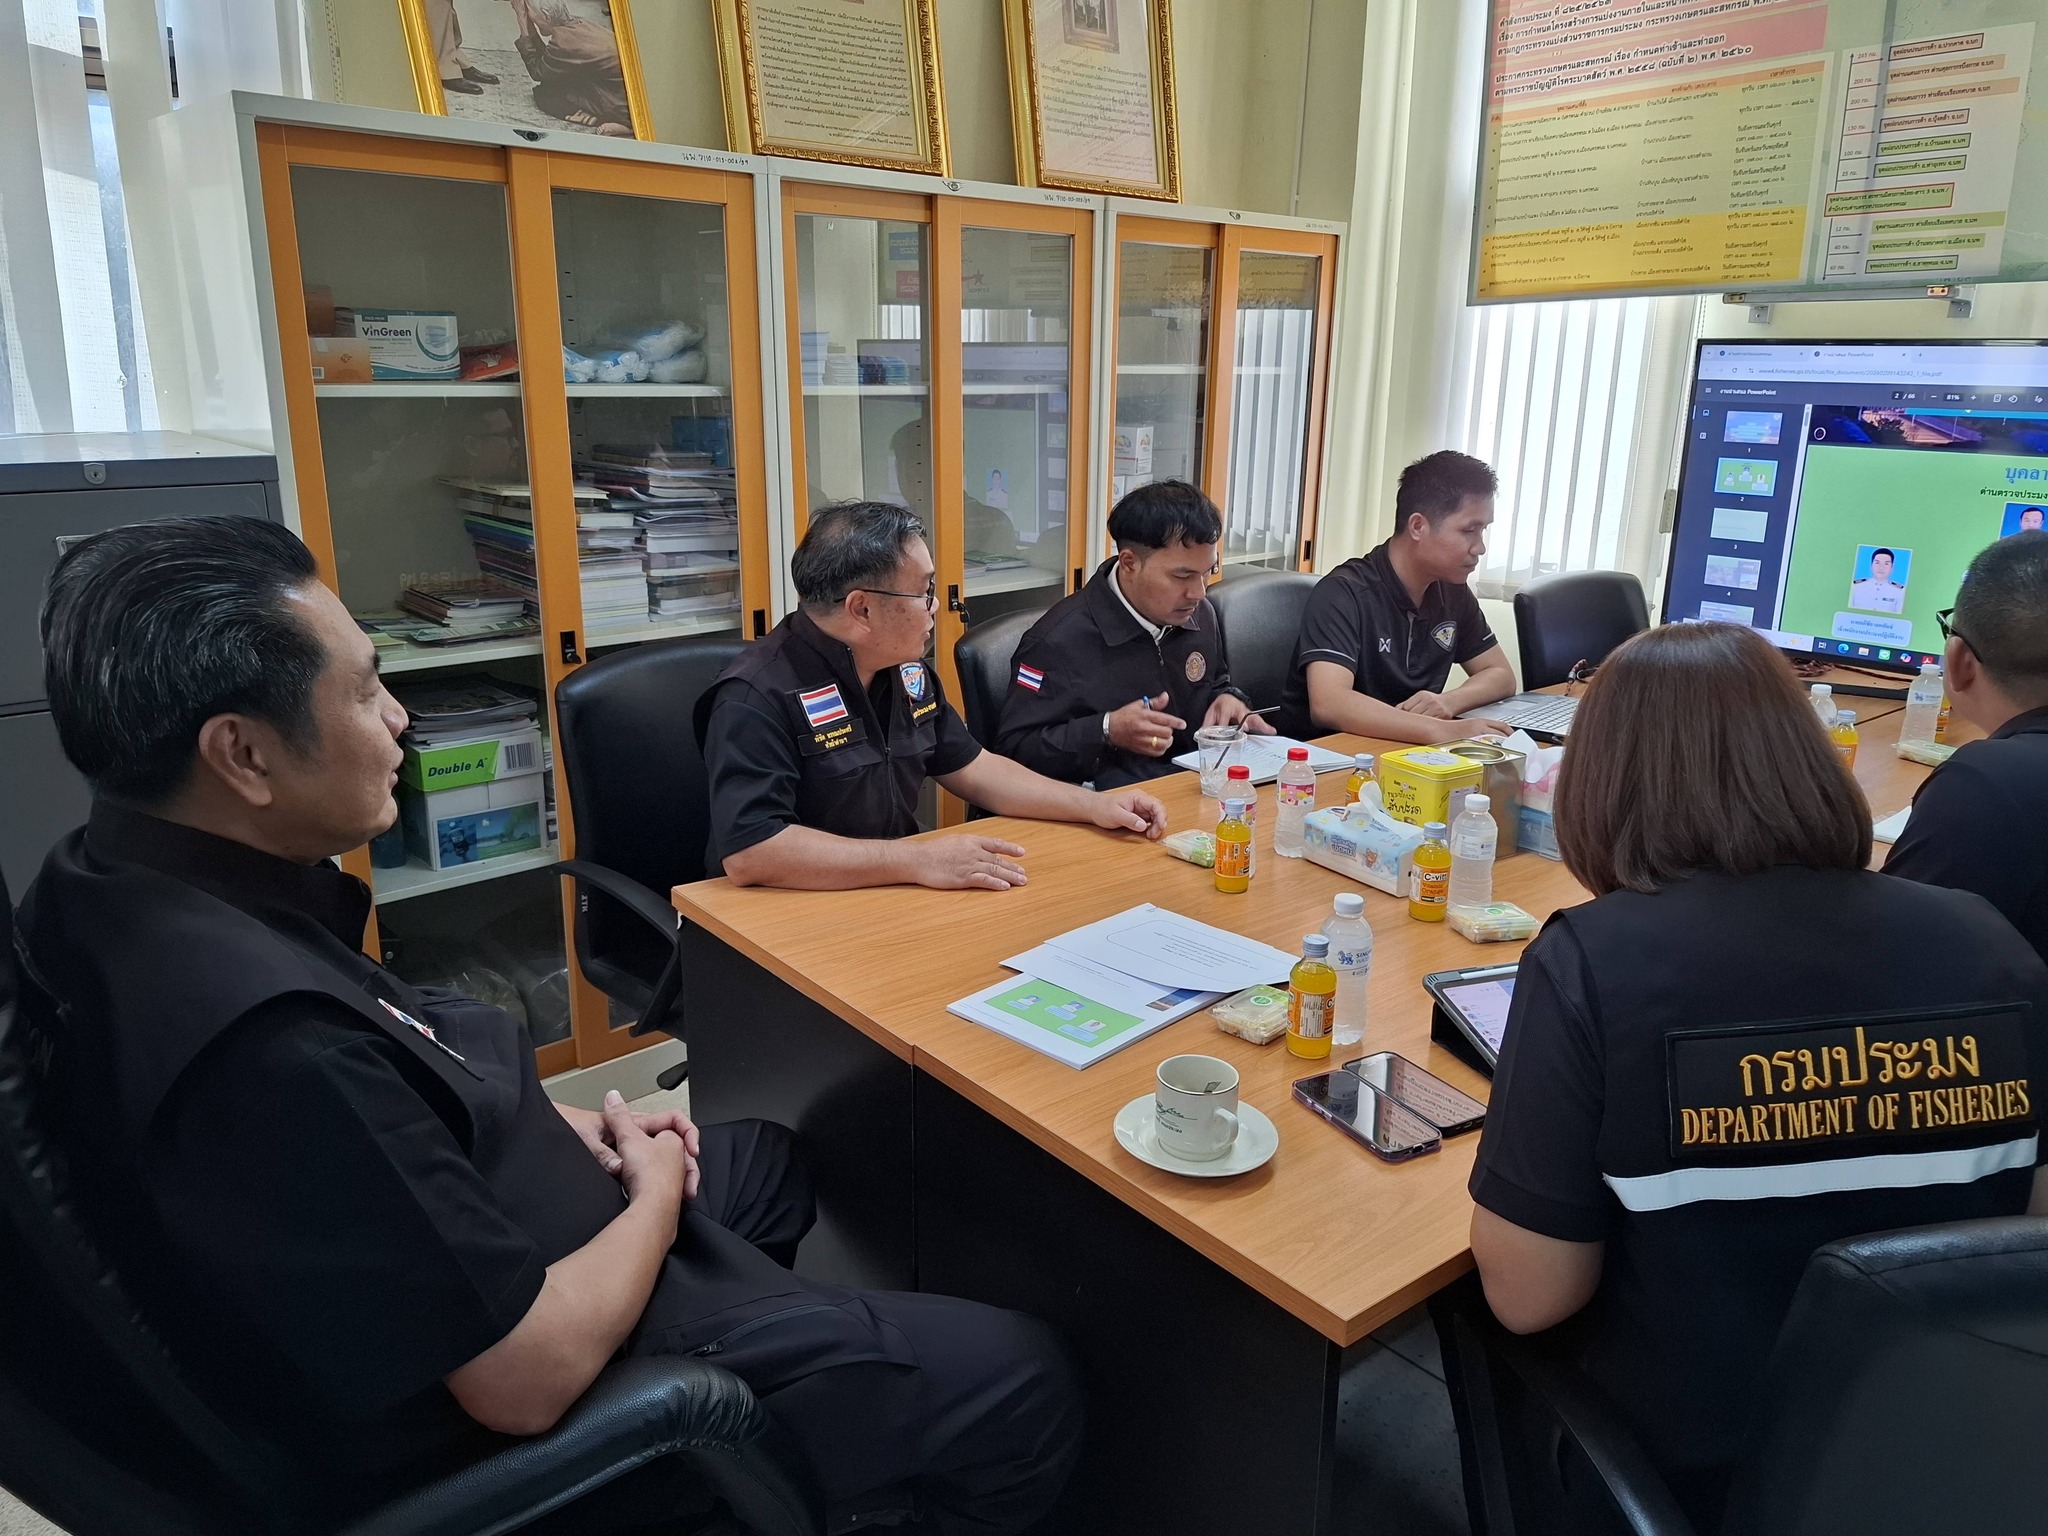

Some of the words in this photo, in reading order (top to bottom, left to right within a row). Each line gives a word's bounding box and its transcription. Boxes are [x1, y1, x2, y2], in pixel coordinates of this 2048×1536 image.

[1500, 10, 1552, 27] คำสั่งกรมประมง
[1498, 31, 1514, 42] เรื่อง
[1496, 54, 1612, 83] ประกาศกระทรวงเกษตรและสหกรณ์
[1614, 51, 1631, 62] เรื่อง
[1633, 34, 1725, 58] กำหนดท่าเข้าและท่าออก
[1495, 69, 1607, 96] ตามพระราชบัญญัติโรคระบาดสัตว์
[362, 325, 412, 337] VinGreen
[427, 761, 472, 778] Double
[476, 758, 485, 770] A
[1739, 1026, 1981, 1096] กรมประมง
[1680, 1096, 1858, 1146] DEPARTMENT
[1867, 1093, 1900, 1130] OF
[1908, 1079, 2030, 1130] FISHERIES
